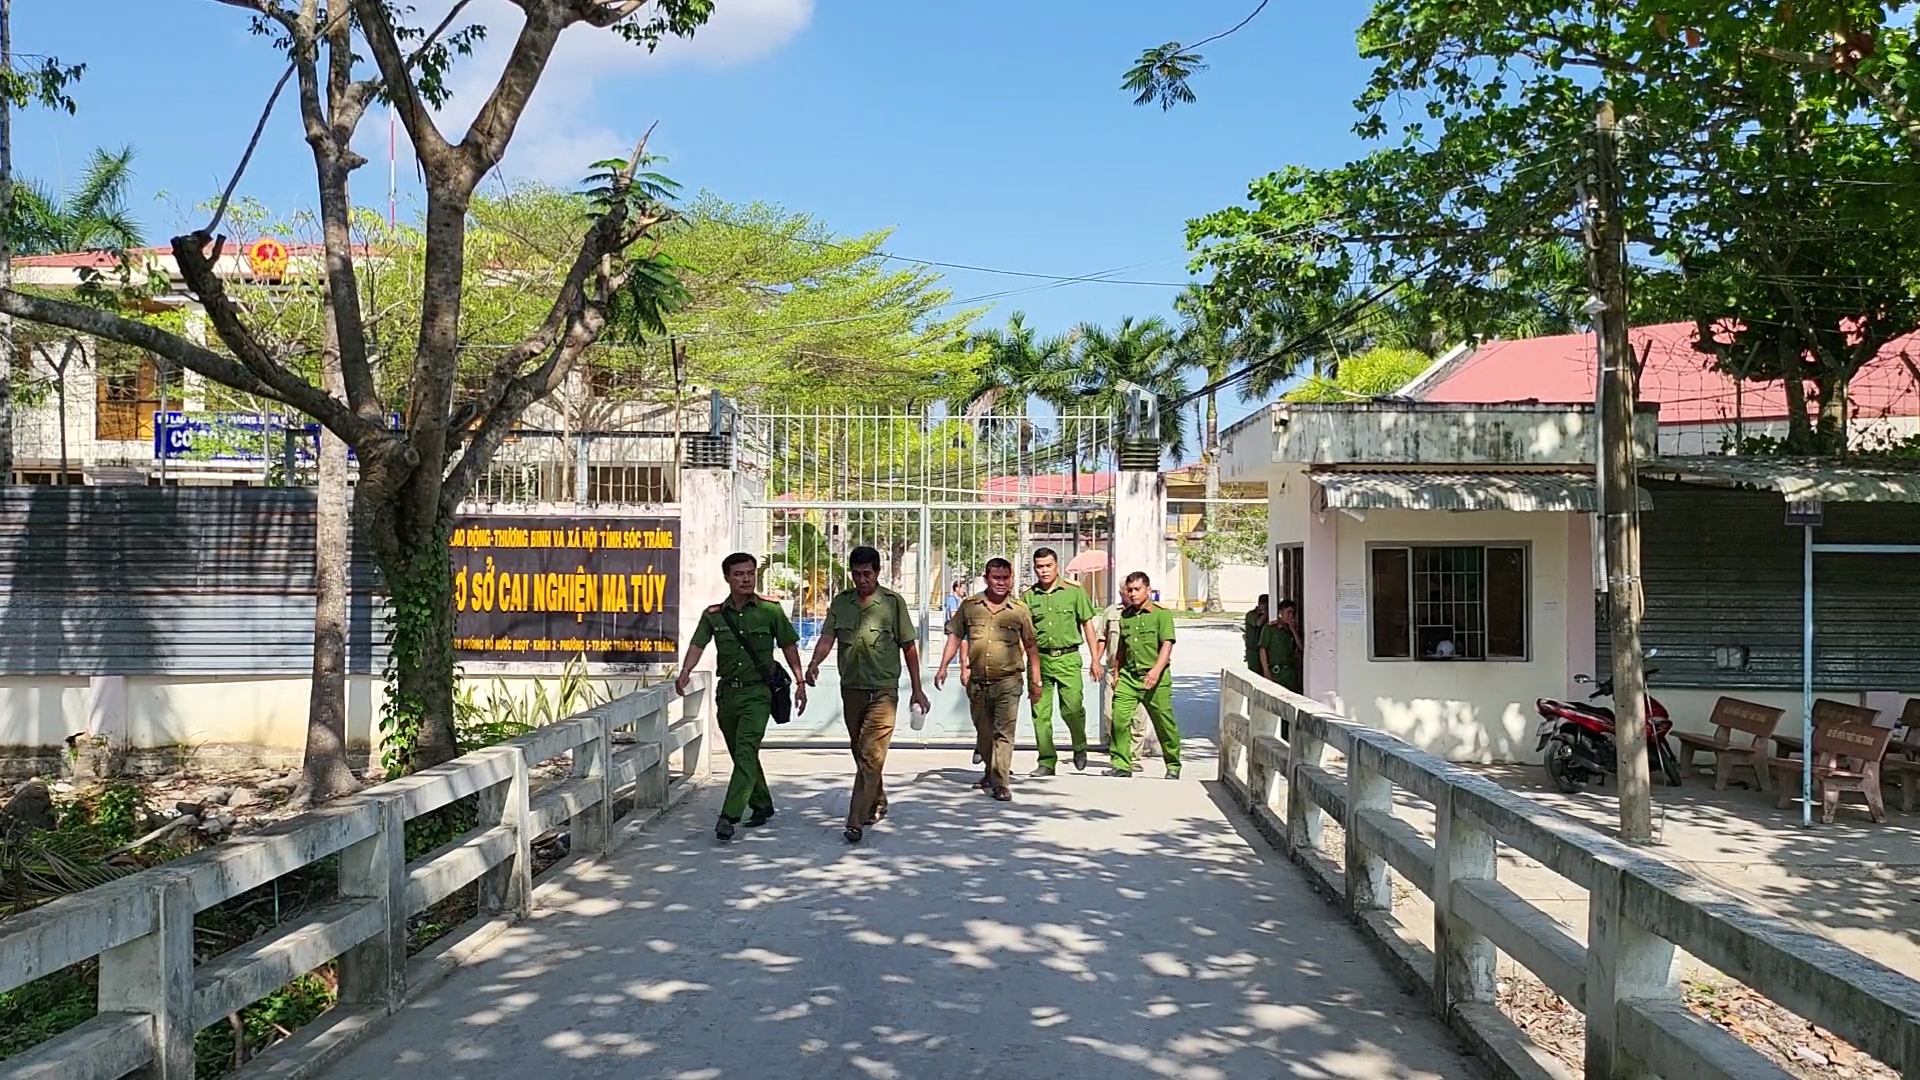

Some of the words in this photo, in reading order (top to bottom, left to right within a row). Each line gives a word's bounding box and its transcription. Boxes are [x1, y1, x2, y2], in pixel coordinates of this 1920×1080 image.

[530, 530, 551, 547] BINH
[553, 526, 565, 547] VÀ
[582, 526, 597, 553] HỘI
[600, 524, 622, 548] TỈNH
[623, 527, 641, 548] SÓC
[643, 527, 673, 548] TRĂNG
[471, 556, 496, 612] SỞ
[498, 572, 528, 612] CAI
[533, 565, 598, 622] NGHIỆN
[602, 574, 628, 612] MA
[630, 565, 667, 613] TÚY
[533, 636, 551, 651] KHÓM
[551, 640, 557, 651] 2
